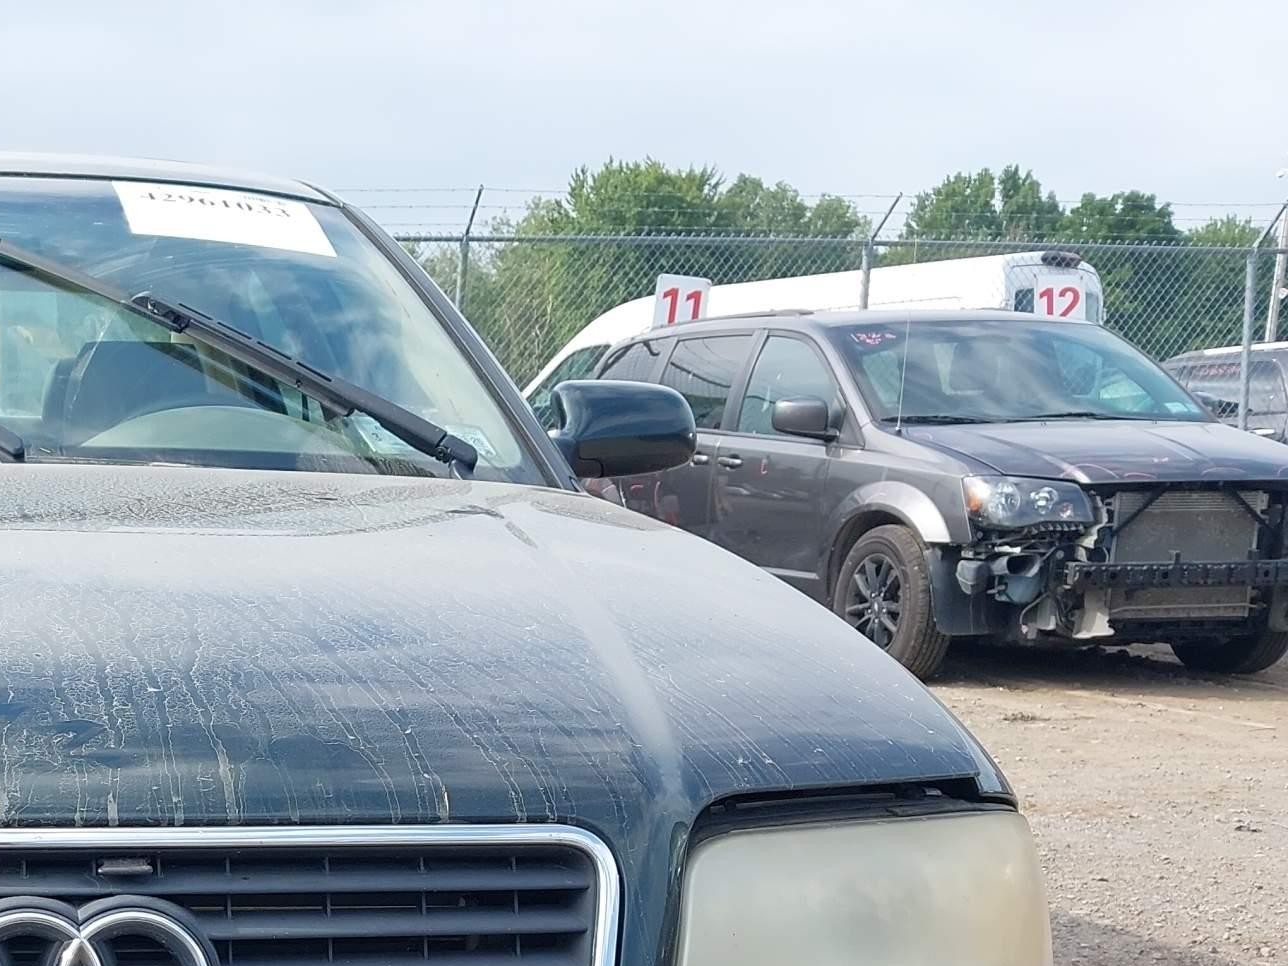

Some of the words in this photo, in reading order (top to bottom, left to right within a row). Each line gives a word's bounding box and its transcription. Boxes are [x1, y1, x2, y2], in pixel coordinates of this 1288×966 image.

[140, 191, 291, 218] 42961033
[662, 287, 702, 325] 11
[1039, 286, 1081, 318] 12
